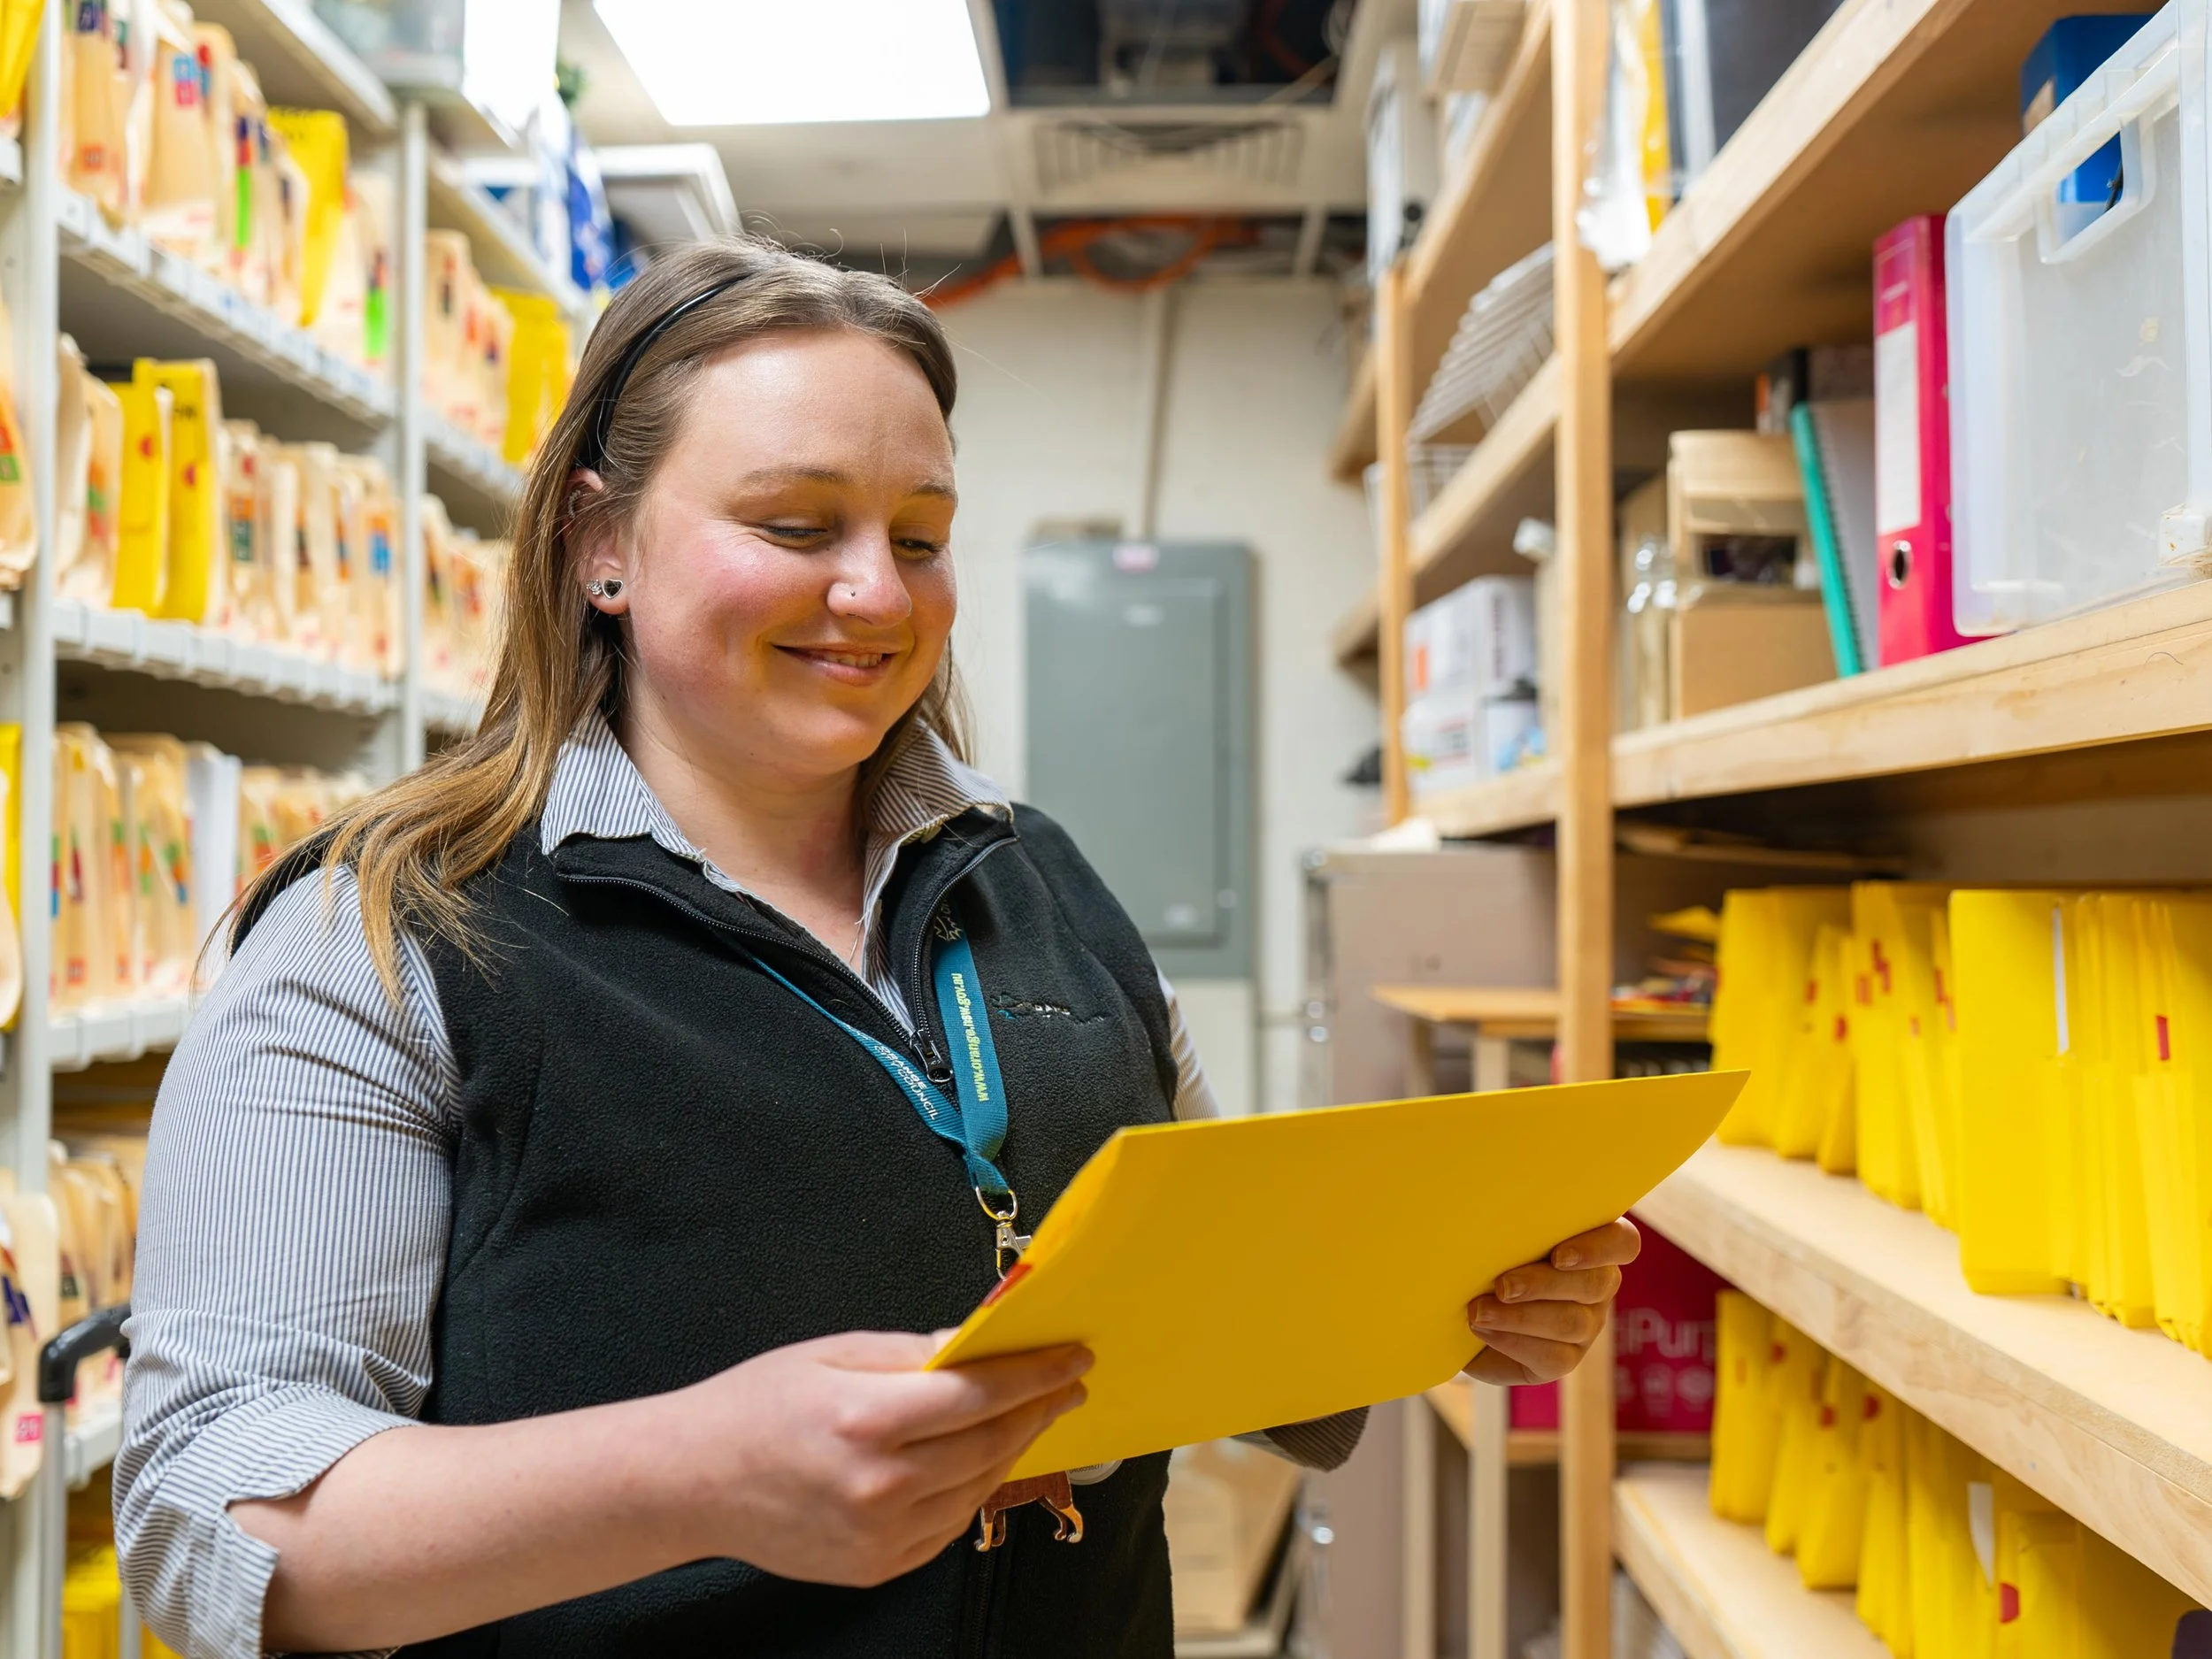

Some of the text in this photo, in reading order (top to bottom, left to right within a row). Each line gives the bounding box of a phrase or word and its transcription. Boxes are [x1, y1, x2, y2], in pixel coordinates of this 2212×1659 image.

[951, 973, 989, 1102] www.orange.nsw.gov.au
[880, 1045, 927, 1090] ORANGE
[897, 1069, 938, 1120] COUNCIL
